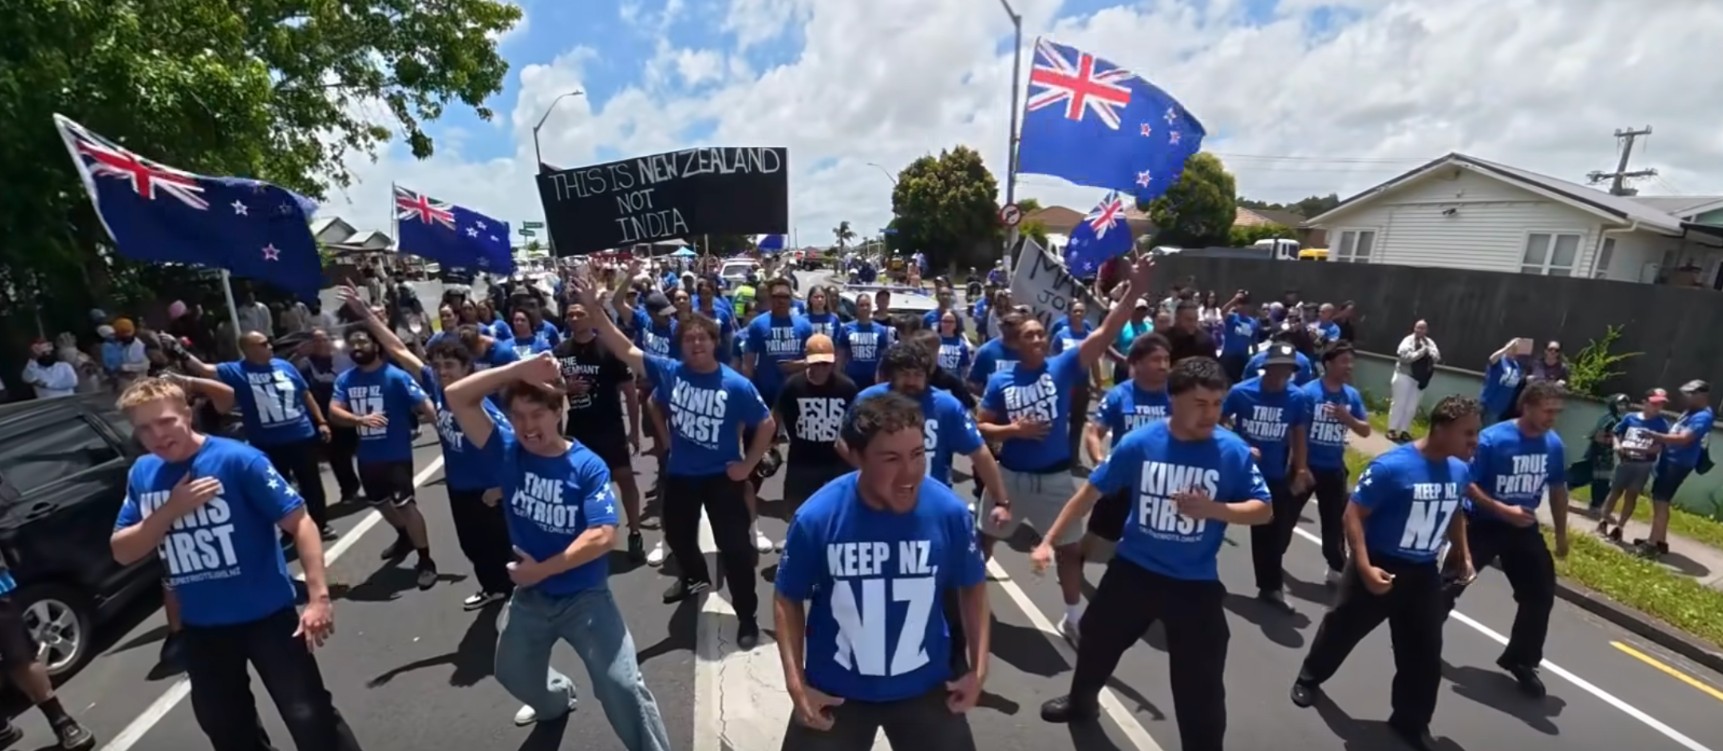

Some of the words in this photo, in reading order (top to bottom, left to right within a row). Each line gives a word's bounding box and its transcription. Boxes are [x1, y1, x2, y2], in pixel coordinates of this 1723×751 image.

[548, 166, 607, 201] THIS
[604, 161, 635, 192] IS
[637, 151, 679, 186] NEW
[680, 146, 781, 179] ZEALAND
[615, 187, 655, 215] NOT
[615, 207, 690, 244] INDIA
[250, 381, 301, 425] NZ
[671, 375, 729, 419] KIWIS
[796, 397, 846, 419] JESUS
[1003, 372, 1057, 411] KIWIS
[1241, 417, 1289, 439] PATRIOT
[1253, 404, 1284, 422] TRUE
[1140, 460, 1220, 502] KIWIS
[1512, 453, 1549, 475] TRUE
[524, 471, 564, 504] TRUE
[1413, 482, 1443, 500] KEEP
[1398, 500, 1459, 551] NZ
[826, 541, 890, 577] KEEP
[898, 539, 939, 577] NZ,
[829, 575, 937, 677] NZ
